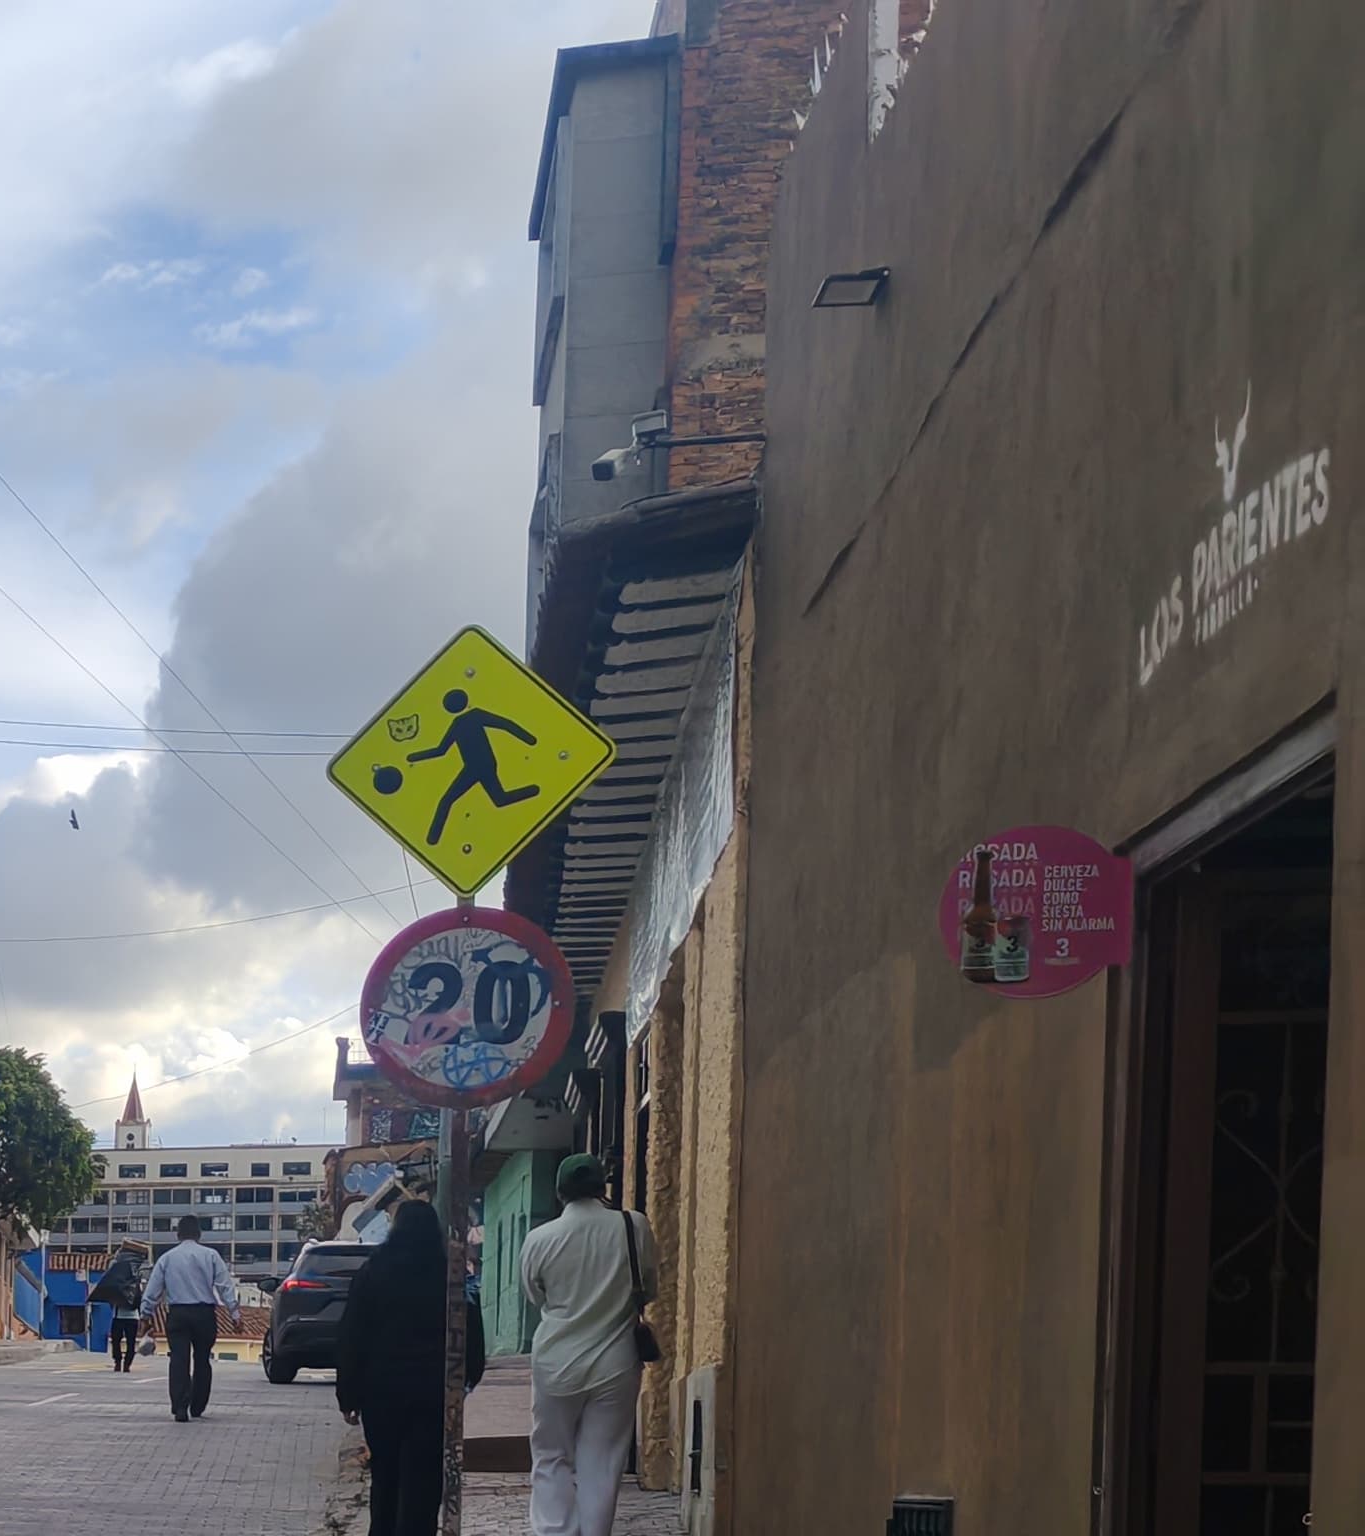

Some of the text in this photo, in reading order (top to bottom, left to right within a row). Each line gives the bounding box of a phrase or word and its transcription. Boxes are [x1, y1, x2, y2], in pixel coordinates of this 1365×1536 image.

[1139, 447, 1331, 686] LOS PARIENTES
[1044, 864, 1100, 878] CERVEZA
[1042, 891, 1080, 905] COMO
[1042, 904, 1084, 918] SIESTA
[1041, 917, 1115, 932] SIN ALARMA
[1055, 937, 1070, 957] 3
[407, 960, 533, 1046] 20
